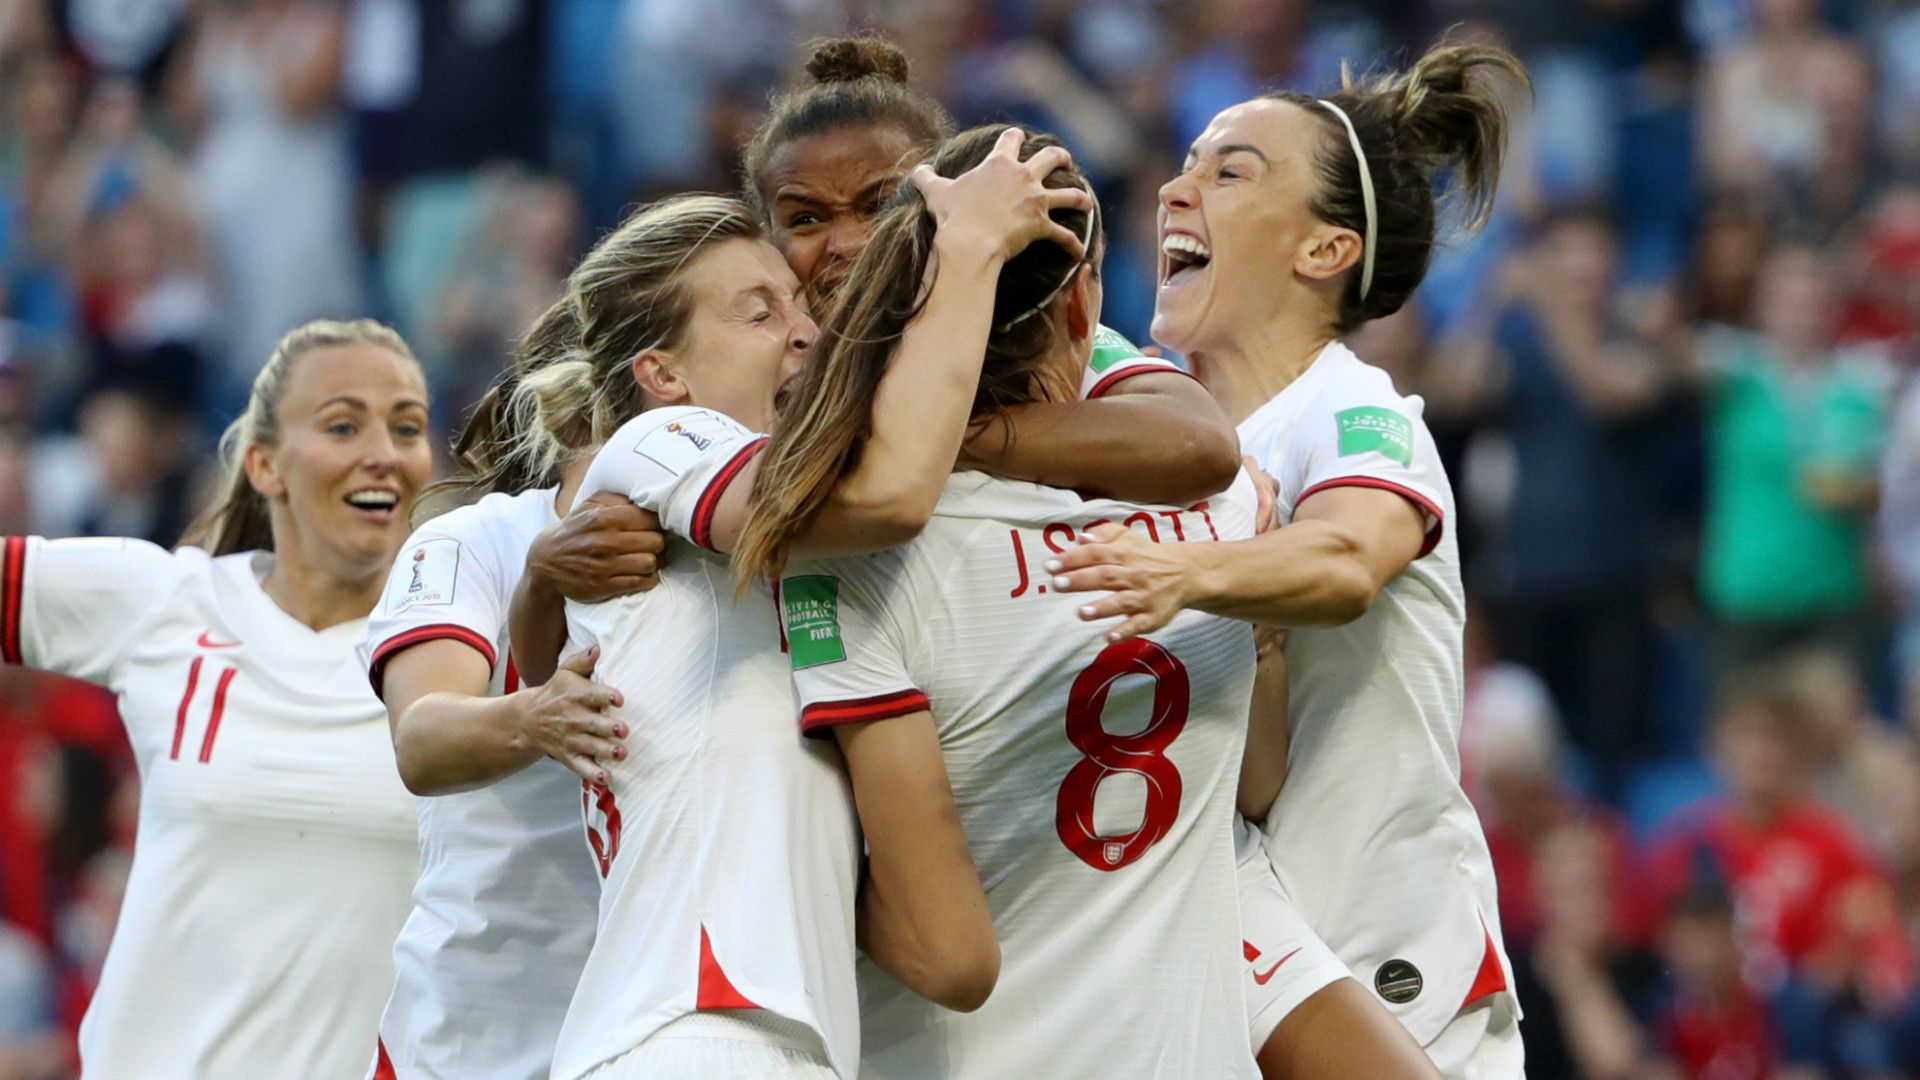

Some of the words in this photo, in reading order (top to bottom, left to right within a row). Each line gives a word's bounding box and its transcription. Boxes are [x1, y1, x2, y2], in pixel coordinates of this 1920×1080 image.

[1010, 501, 1219, 599] J.SOTT
[785, 600, 833, 614] LIVING
[810, 627, 834, 641] FIFA
[170, 655, 238, 764] 11
[1056, 637, 1190, 872] 8
